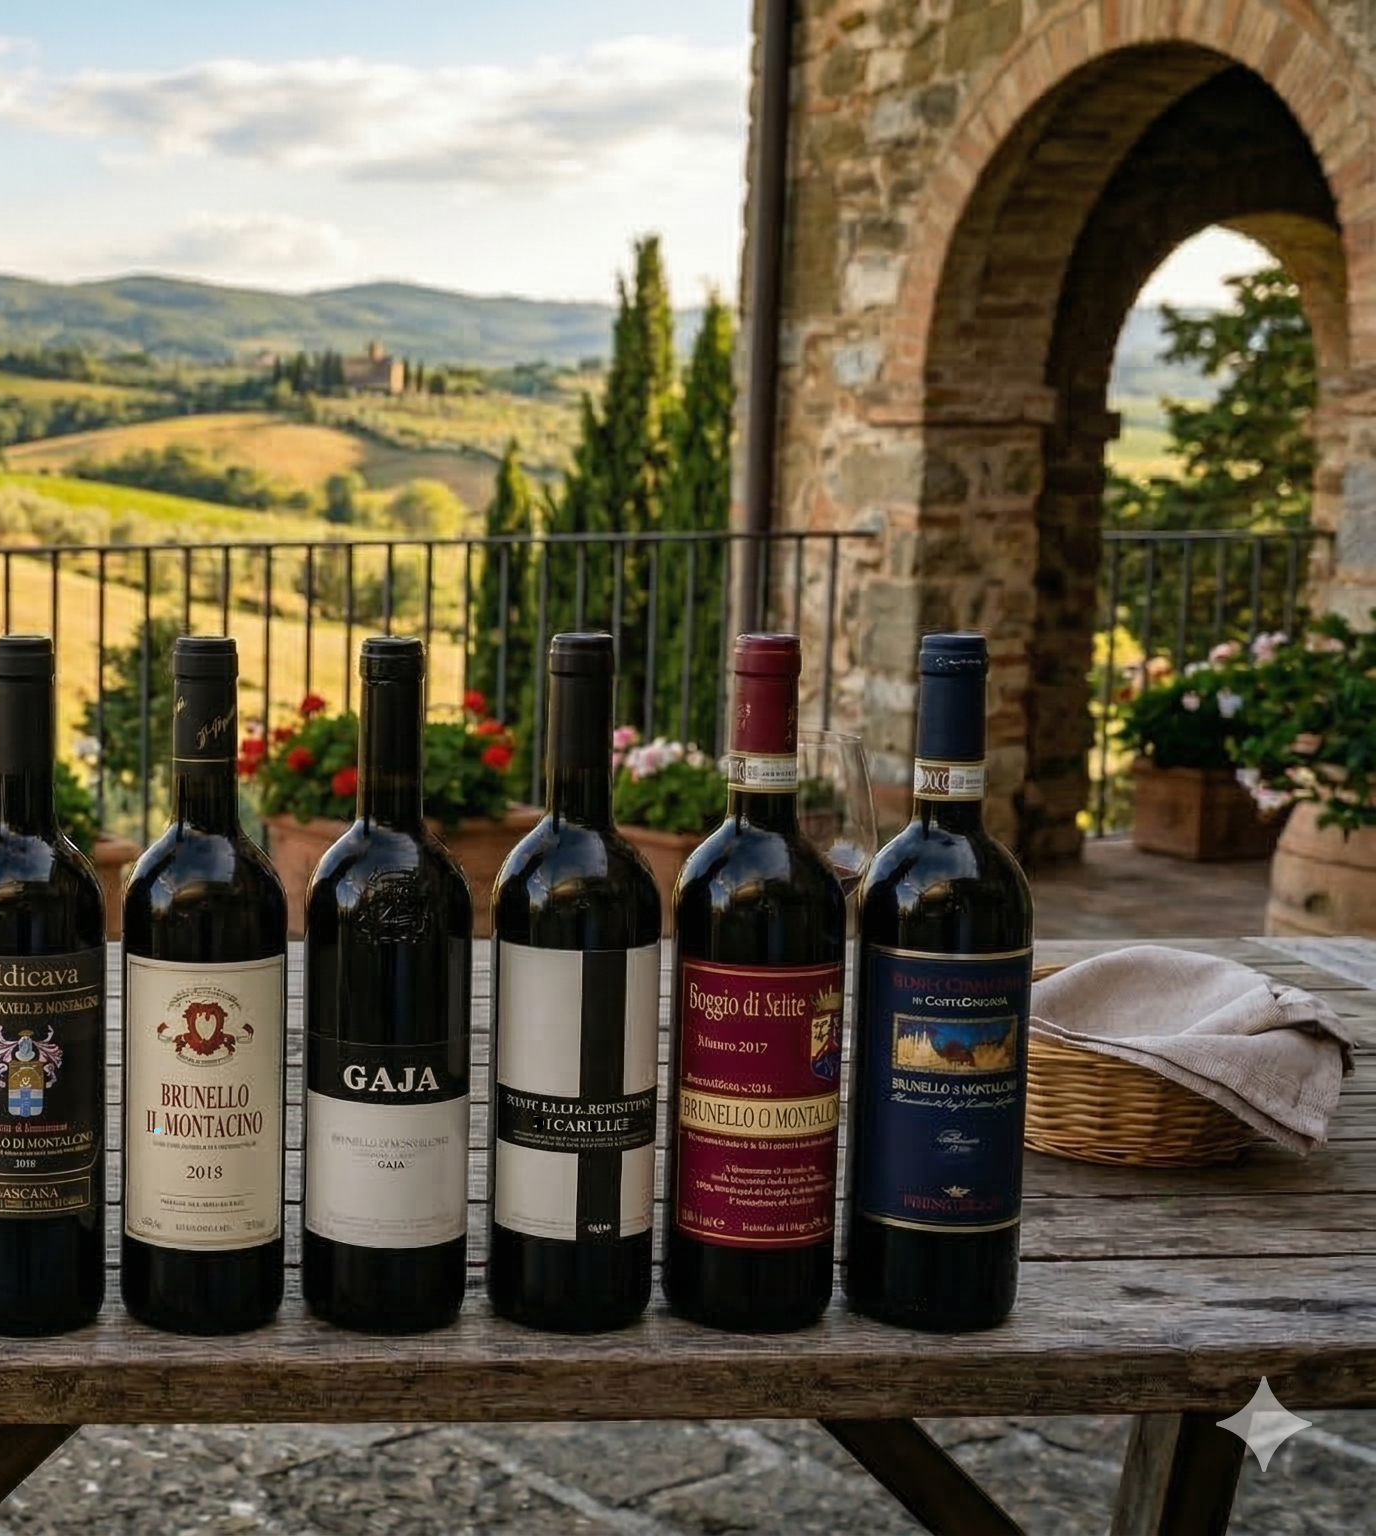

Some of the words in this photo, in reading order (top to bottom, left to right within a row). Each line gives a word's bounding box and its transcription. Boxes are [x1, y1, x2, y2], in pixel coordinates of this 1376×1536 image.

[743, 991, 760, 1017] di
[739, 1041, 768, 1054] 2017
[343, 1065, 440, 1092] GAJA
[161, 1083, 249, 1109] BRUNELLO
[164, 1110, 263, 1138] MONTACINO
[684, 1097, 755, 1128] BRUNELLO
[12, 1138, 25, 1149] DI
[186, 1165, 223, 1180] 2018
